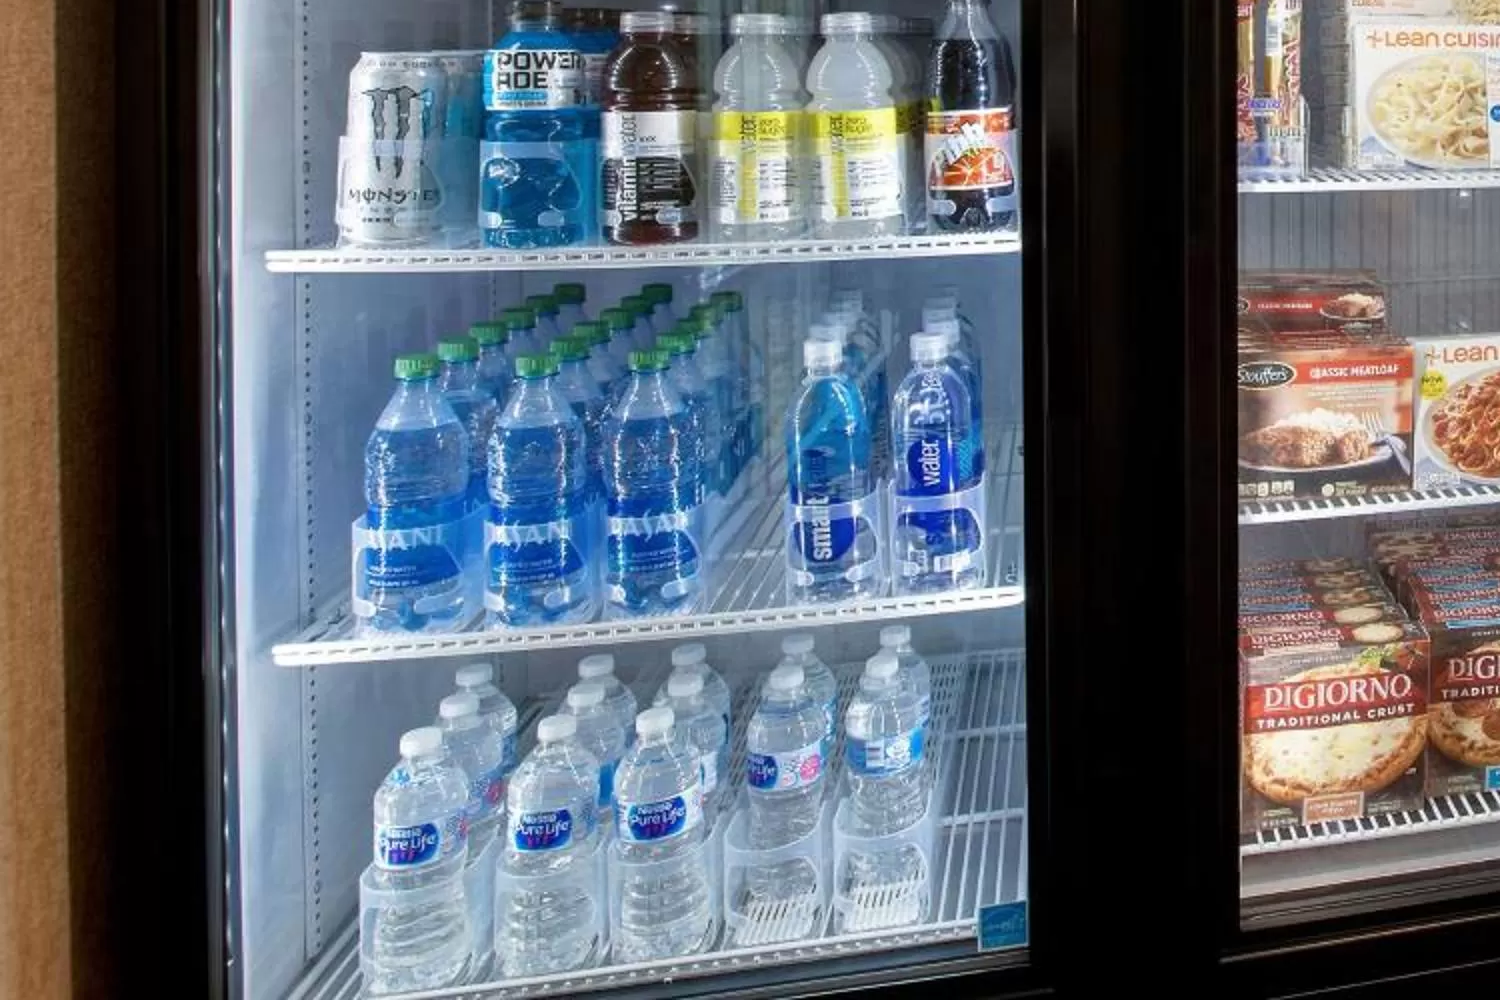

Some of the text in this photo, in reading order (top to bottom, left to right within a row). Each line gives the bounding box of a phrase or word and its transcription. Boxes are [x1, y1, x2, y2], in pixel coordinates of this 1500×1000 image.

[496, 71, 549, 89] ADE
[1309, 365, 1400, 380] CLASSIC MEATLOAF
[917, 439, 941, 488] water
[1256, 703, 1416, 730] TRADITIONAL CRUST
[631, 807, 686, 826] Pure Life
[516, 820, 570, 837] Pure Life
[380, 833, 437, 853] Pure Life
